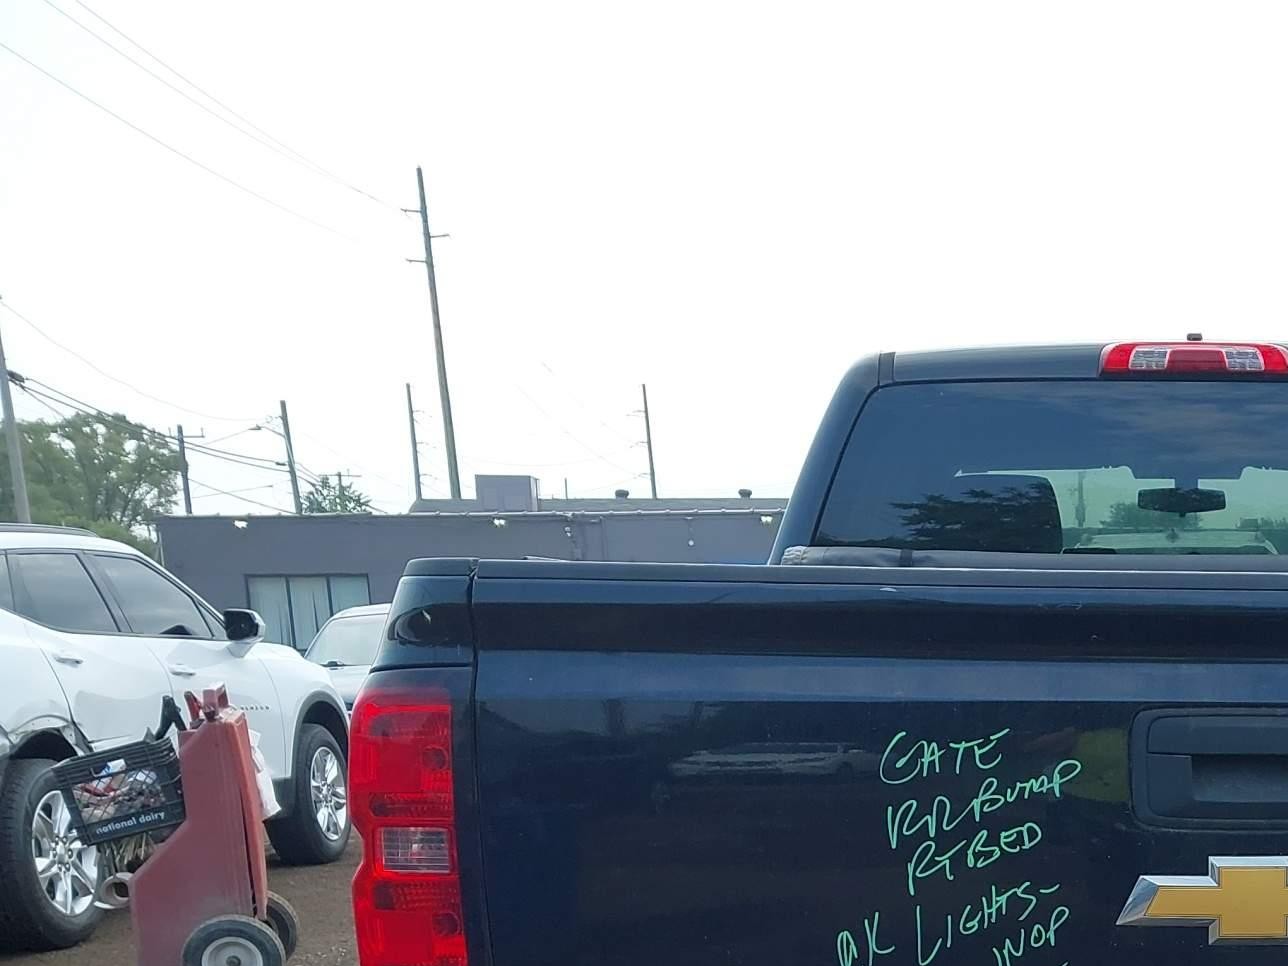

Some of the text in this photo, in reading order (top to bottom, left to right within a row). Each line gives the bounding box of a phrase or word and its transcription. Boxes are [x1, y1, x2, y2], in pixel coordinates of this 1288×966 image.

[879, 728, 1010, 784] GATE
[96, 811, 165, 835] national dairy
[967, 822, 1042, 868] BED
